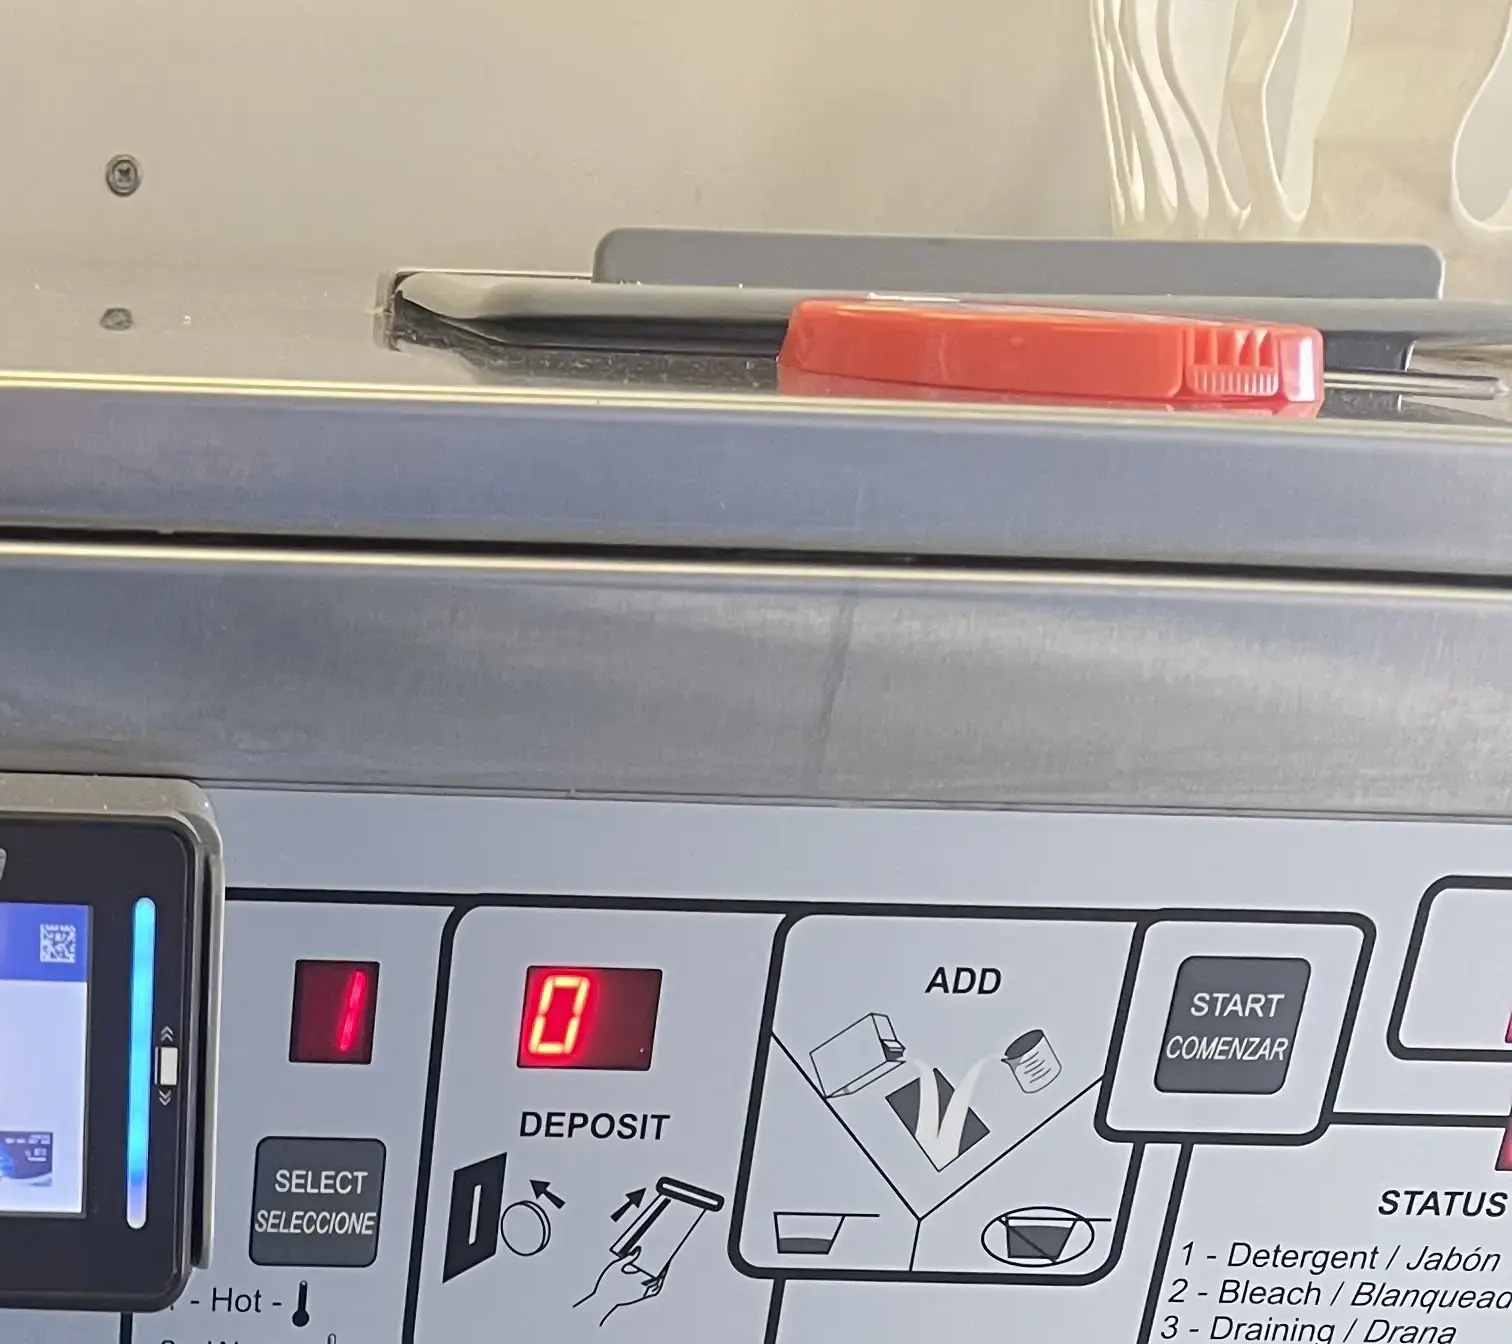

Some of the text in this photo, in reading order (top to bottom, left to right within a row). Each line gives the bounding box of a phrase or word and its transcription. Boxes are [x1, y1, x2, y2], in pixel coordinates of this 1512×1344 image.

[924, 966, 1001, 994] ADD
[338, 969, 367, 1051] 1
[528, 974, 589, 1054] 0
[1190, 992, 1285, 1017] START
[1166, 1035, 1288, 1061] COMENZAR
[519, 1111, 670, 1140] DEPOSIT
[274, 1170, 368, 1195] SELECT
[1378, 1189, 1507, 1217] STATUS
[254, 1210, 376, 1235] SELECCIONE
[1181, 1242, 1501, 1274] 1 Detergent Jabón
[211, 1288, 262, 1313] Hot
[1168, 1279, 1188, 1303] 2
[1218, 1280, 1322, 1306] Bleach
[1160, 1316, 1179, 1340] 3
[1363, 1319, 1457, 1344] Drana
